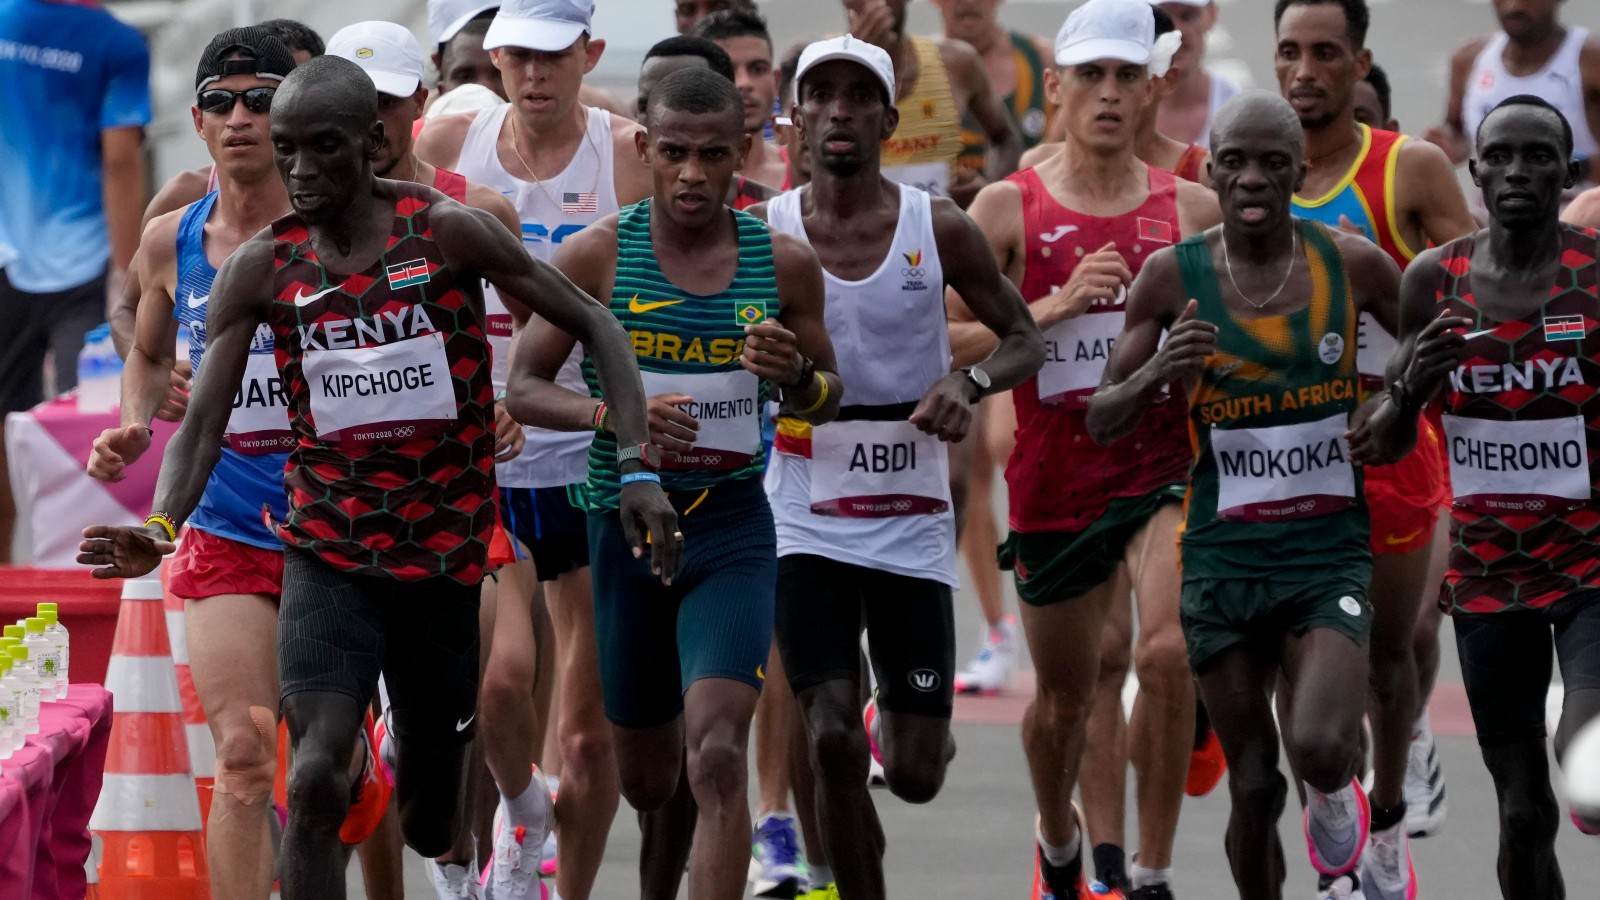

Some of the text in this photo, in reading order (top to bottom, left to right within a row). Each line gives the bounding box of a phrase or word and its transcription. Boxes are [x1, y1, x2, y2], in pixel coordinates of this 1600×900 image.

[298, 303, 435, 350] KENYA
[321, 363, 434, 398] KIPCHOGE
[1449, 357, 1585, 393] KENYA
[677, 398, 753, 420] SCIMENTO
[1201, 379, 1353, 424] SOUTH AFRICA
[240, 439, 278, 448] TOKYO 2020
[353, 431, 393, 441] TOKYO 2020
[849, 441, 916, 473] ABDI
[1220, 438, 1344, 479] MOKOKA
[1453, 436, 1582, 471] CHERONO
[852, 503, 891, 512] TOKYO 2020
[1258, 508, 1280, 516] TOKYO
[1486, 500, 1523, 510] TOKYO 2020
